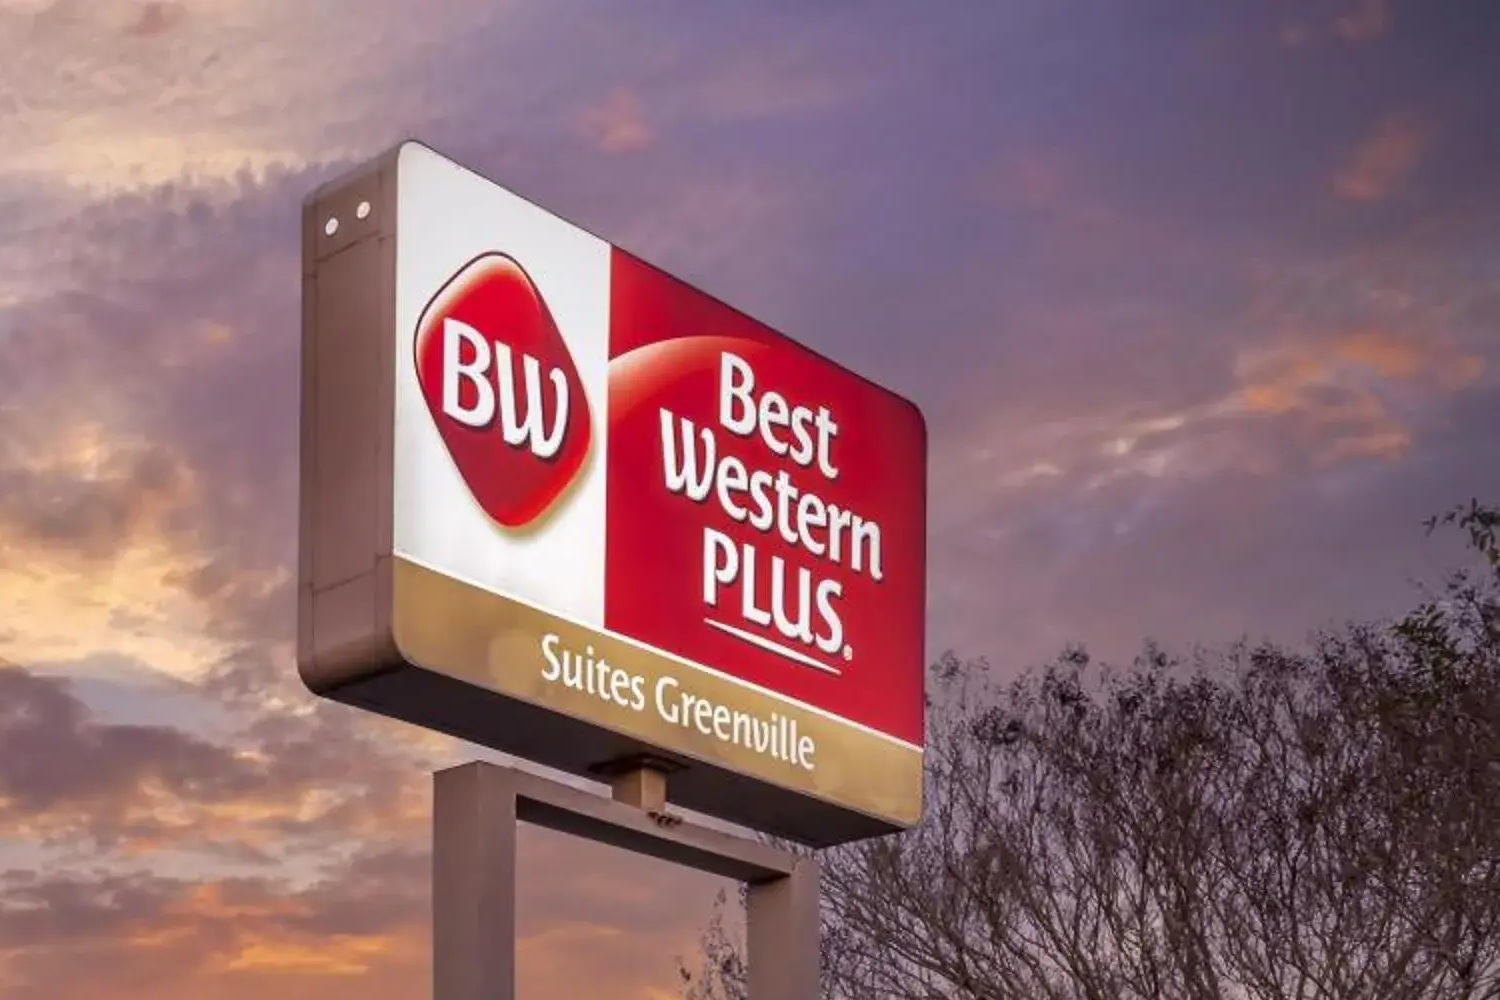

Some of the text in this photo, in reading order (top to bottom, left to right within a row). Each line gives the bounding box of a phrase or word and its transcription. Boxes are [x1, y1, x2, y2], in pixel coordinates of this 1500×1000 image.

[443, 317, 569, 458] BW
[720, 351, 838, 479] Best
[659, 407, 883, 581] Western
[541, 633, 815, 770] Suites Greenville
